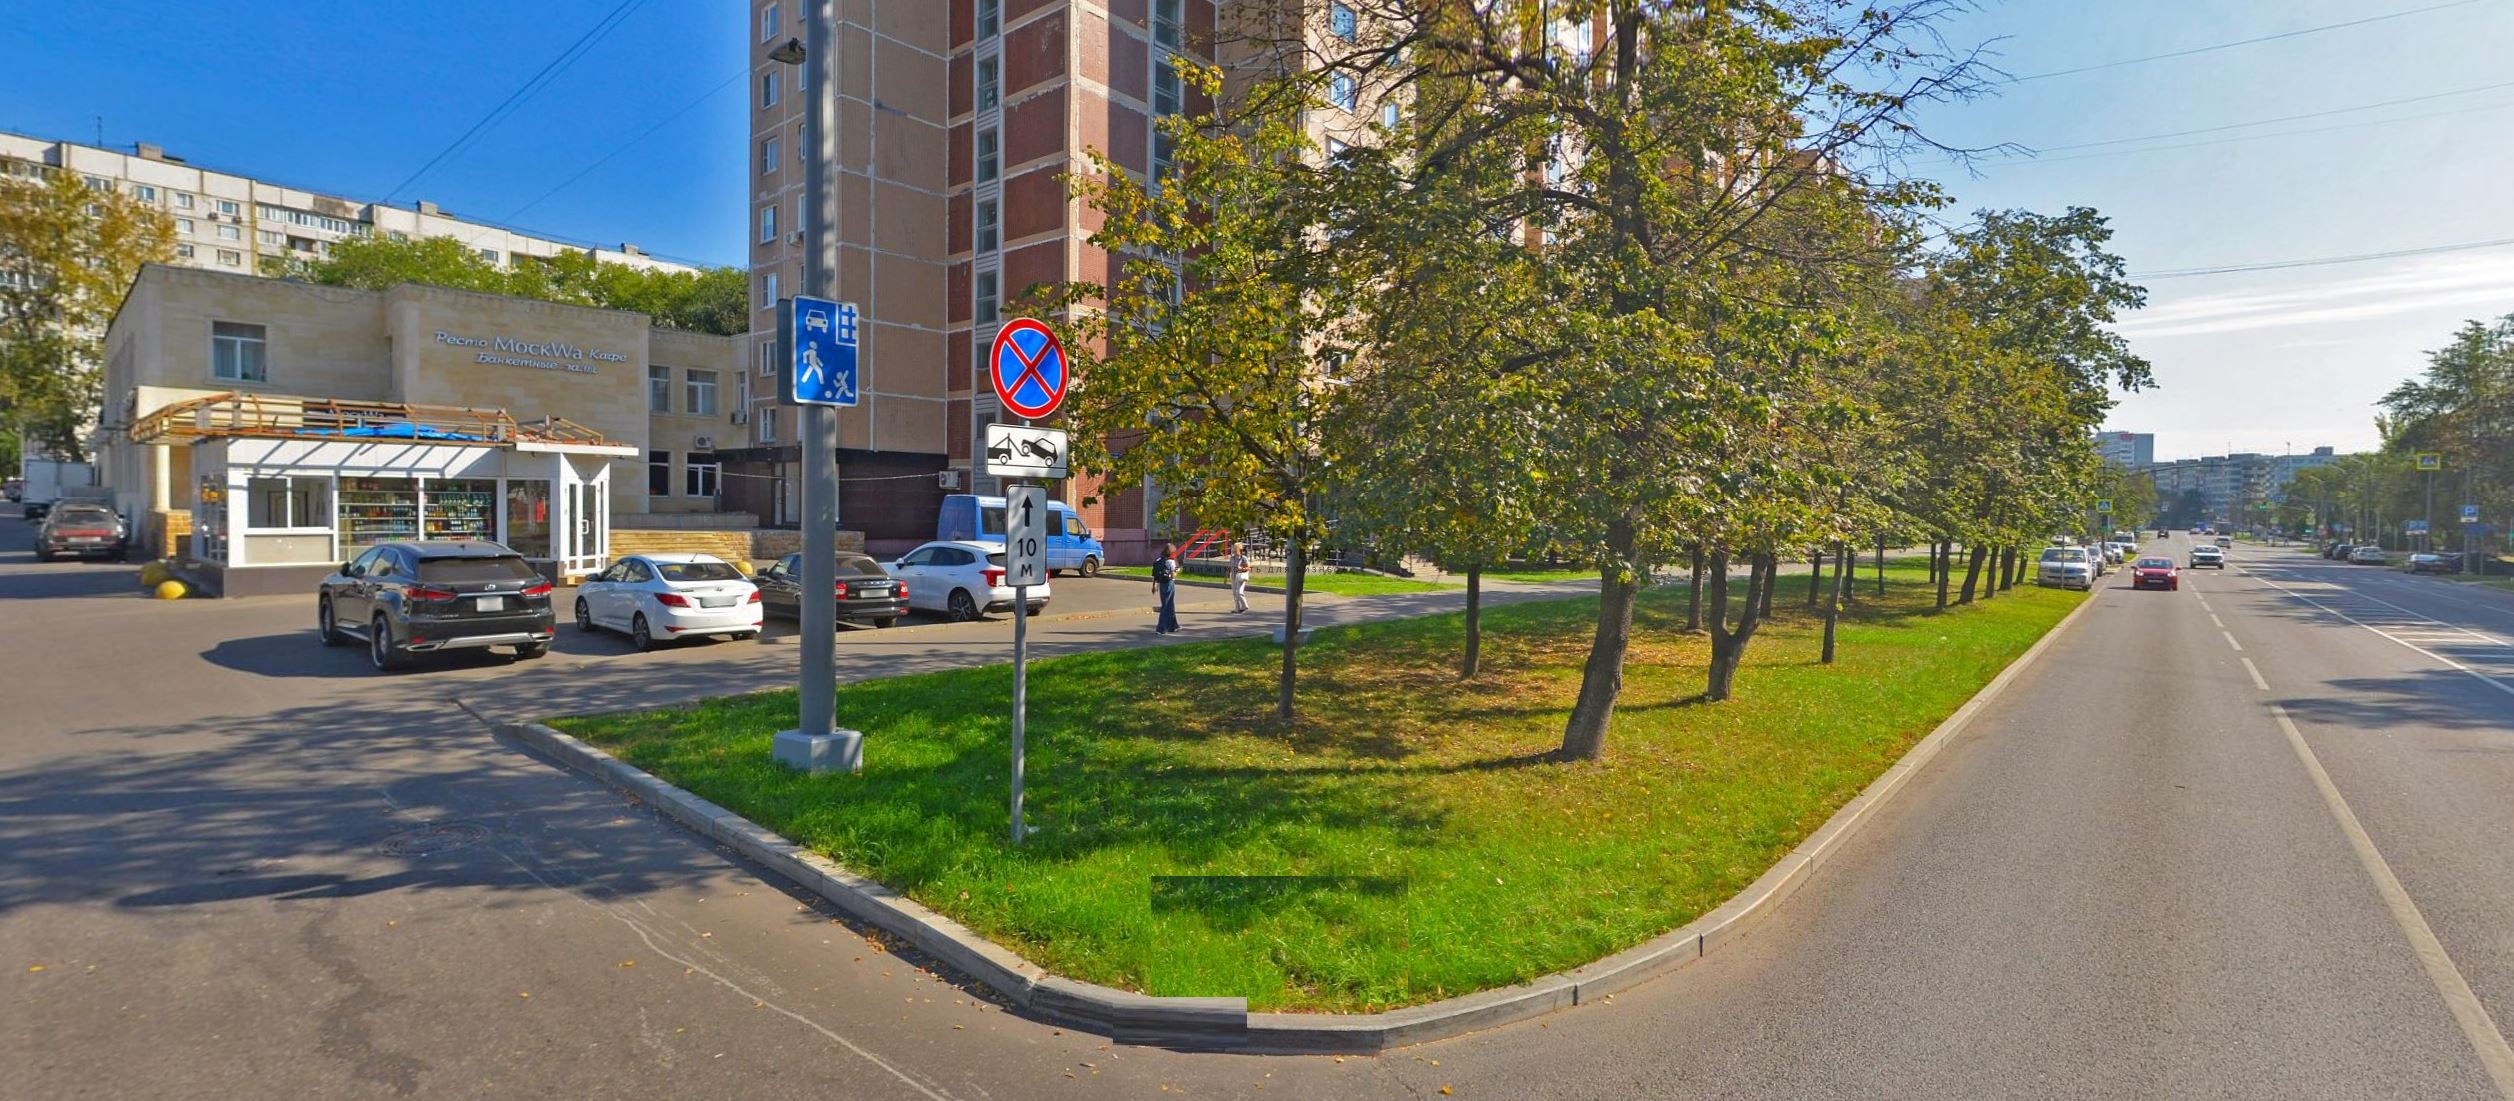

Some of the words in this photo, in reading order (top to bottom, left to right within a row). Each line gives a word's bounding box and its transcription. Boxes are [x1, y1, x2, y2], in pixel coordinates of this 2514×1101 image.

[434, 330, 489, 348] Ресто
[588, 347, 628, 363] Кафе
[477, 352, 559, 370] Банкетные
[1016, 537, 1037, 558] 10
